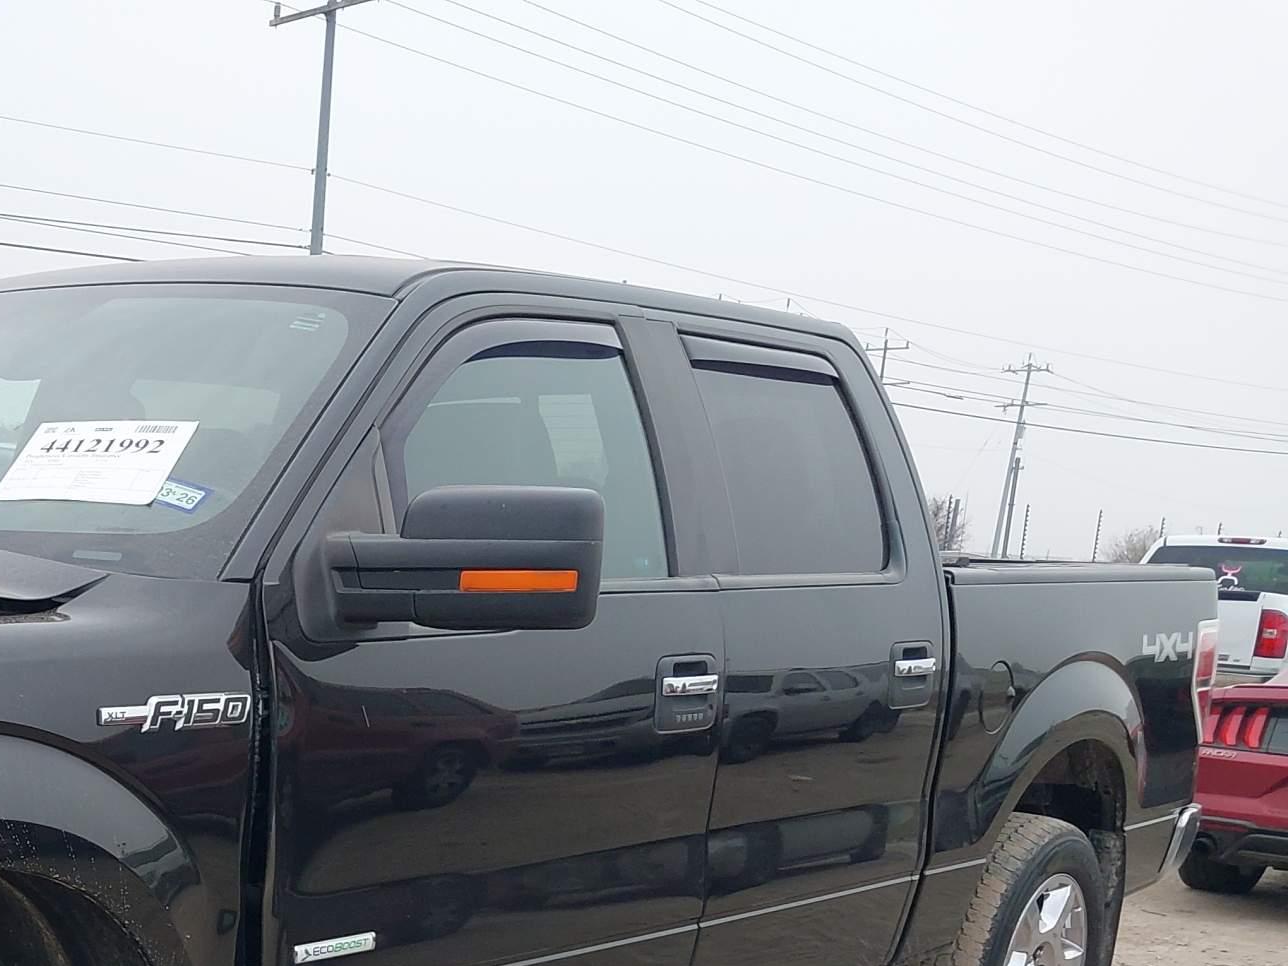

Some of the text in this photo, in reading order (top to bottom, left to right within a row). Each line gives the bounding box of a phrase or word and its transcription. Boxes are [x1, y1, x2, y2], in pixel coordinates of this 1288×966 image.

[40, 438, 165, 454] 44121992
[175, 492, 198, 505] 26
[106, 693, 251, 733] XLT F-150
